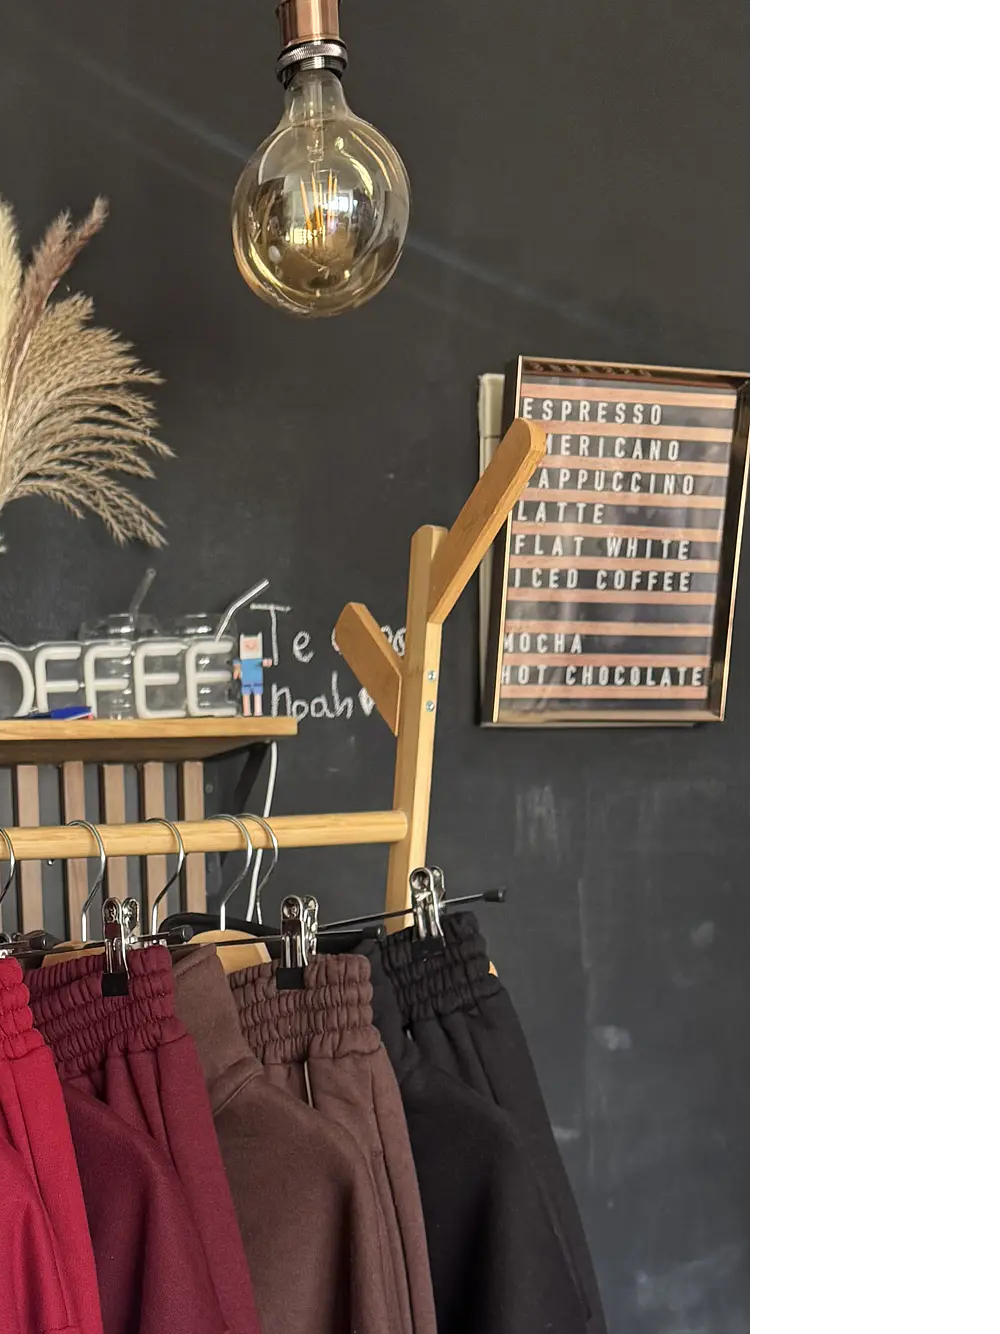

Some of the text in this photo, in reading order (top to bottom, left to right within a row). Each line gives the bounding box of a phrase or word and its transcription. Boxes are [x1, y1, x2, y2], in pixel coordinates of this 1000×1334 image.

[523, 398, 662, 425] ESPRESSO
[546, 434, 679, 461] ERICANO
[525, 468, 694, 495] APPUCCINO
[517, 500, 605, 524] LATTE
[515, 534, 690, 560] FLAT WHITE
[514, 568, 691, 592] ICED COFFEE
[250, 603, 315, 666] Te
[501, 664, 703, 687] HOT CHOCOLATE
